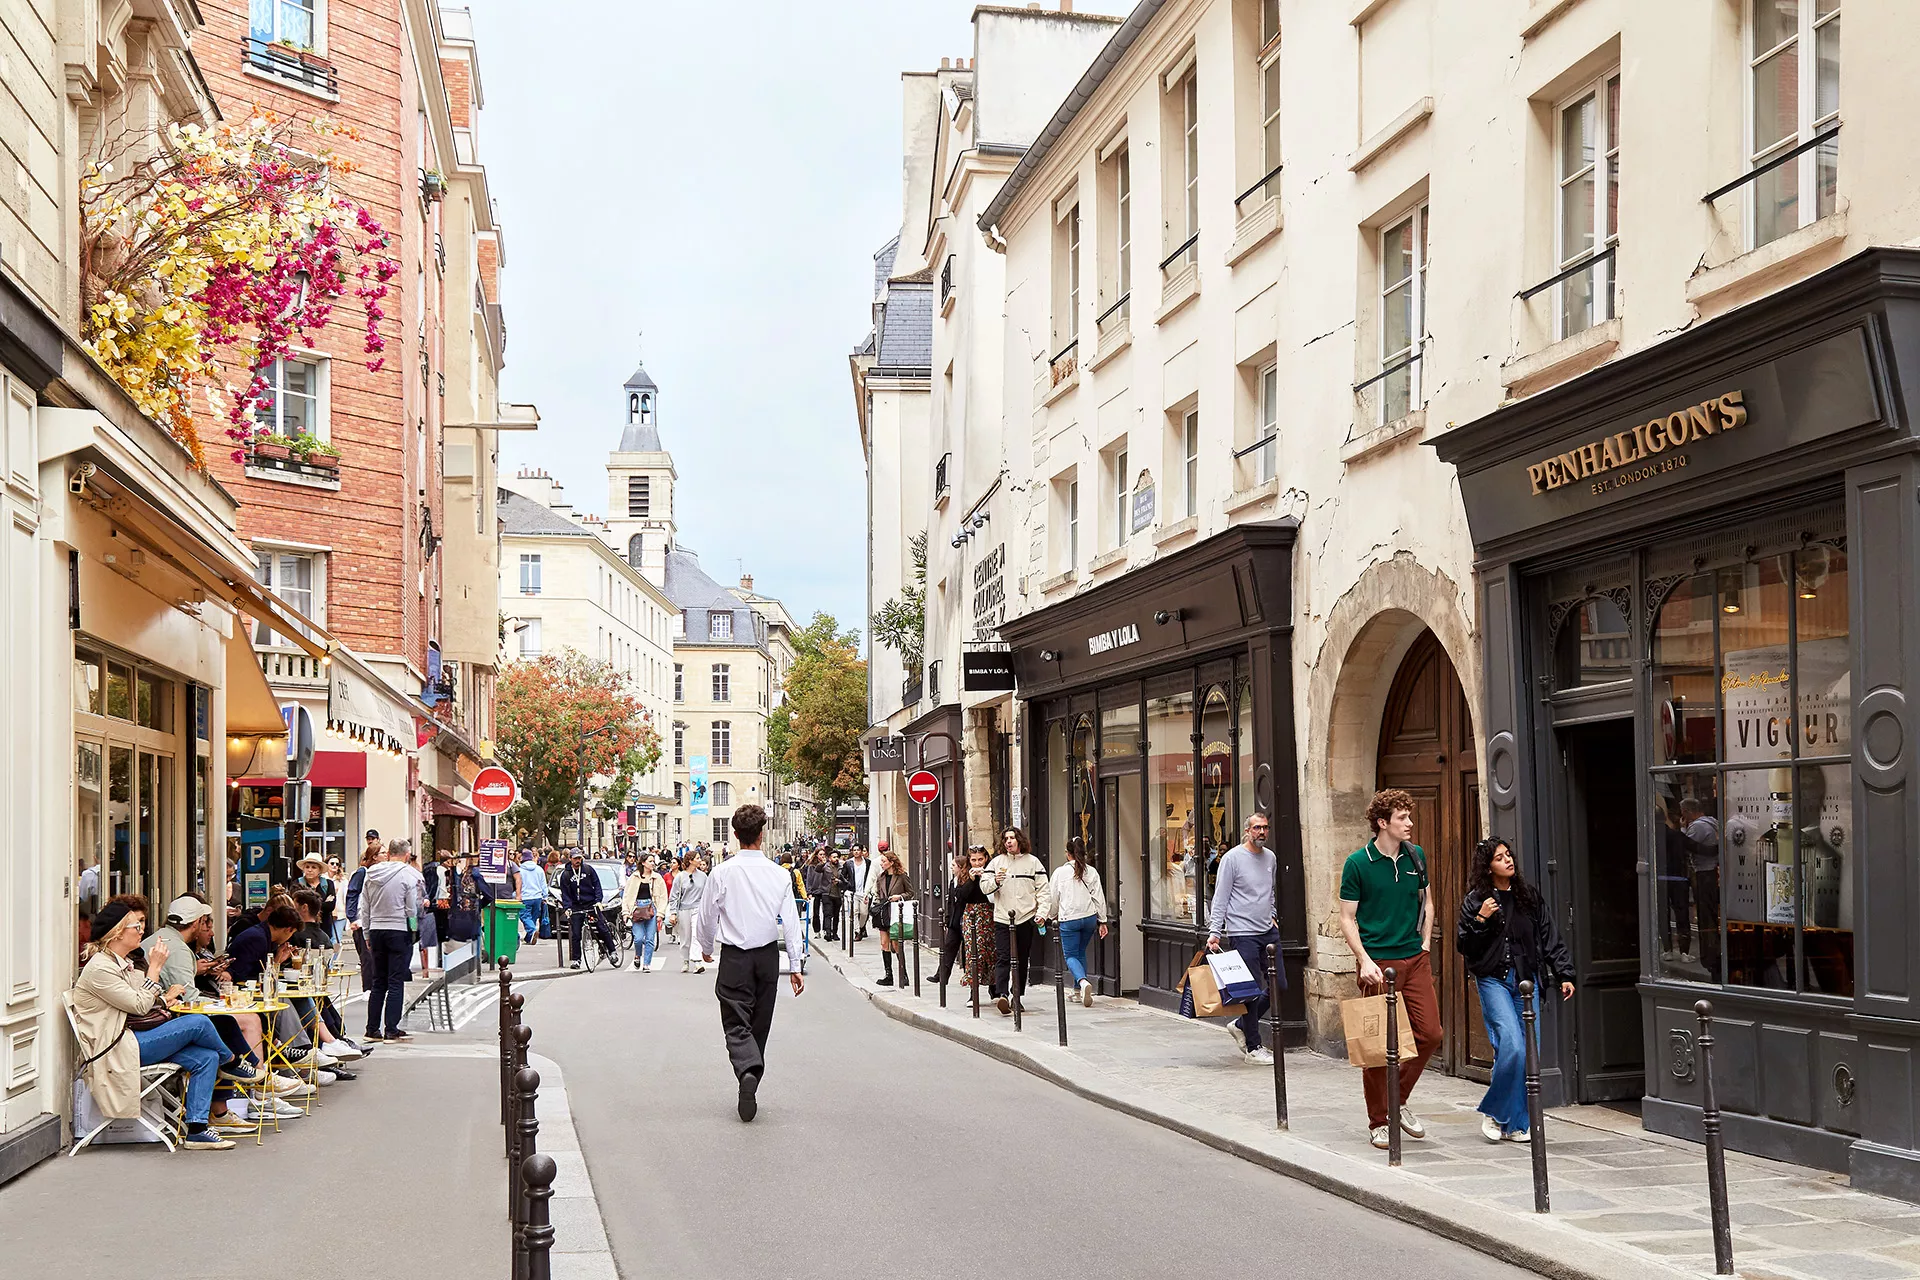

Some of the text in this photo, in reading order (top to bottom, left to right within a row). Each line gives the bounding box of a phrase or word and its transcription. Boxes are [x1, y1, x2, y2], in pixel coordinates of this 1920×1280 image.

[1526, 390, 1747, 496] PENHALIGON'S
[1614, 466, 1657, 488] LONDON
[1661, 455, 1687, 473] 1870
[973, 548, 999, 590] CENTRE
[972, 575, 1005, 619] CULTUREL
[1088, 623, 1140, 656] BIMBA Y LOLA
[250, 845, 265, 866] P
